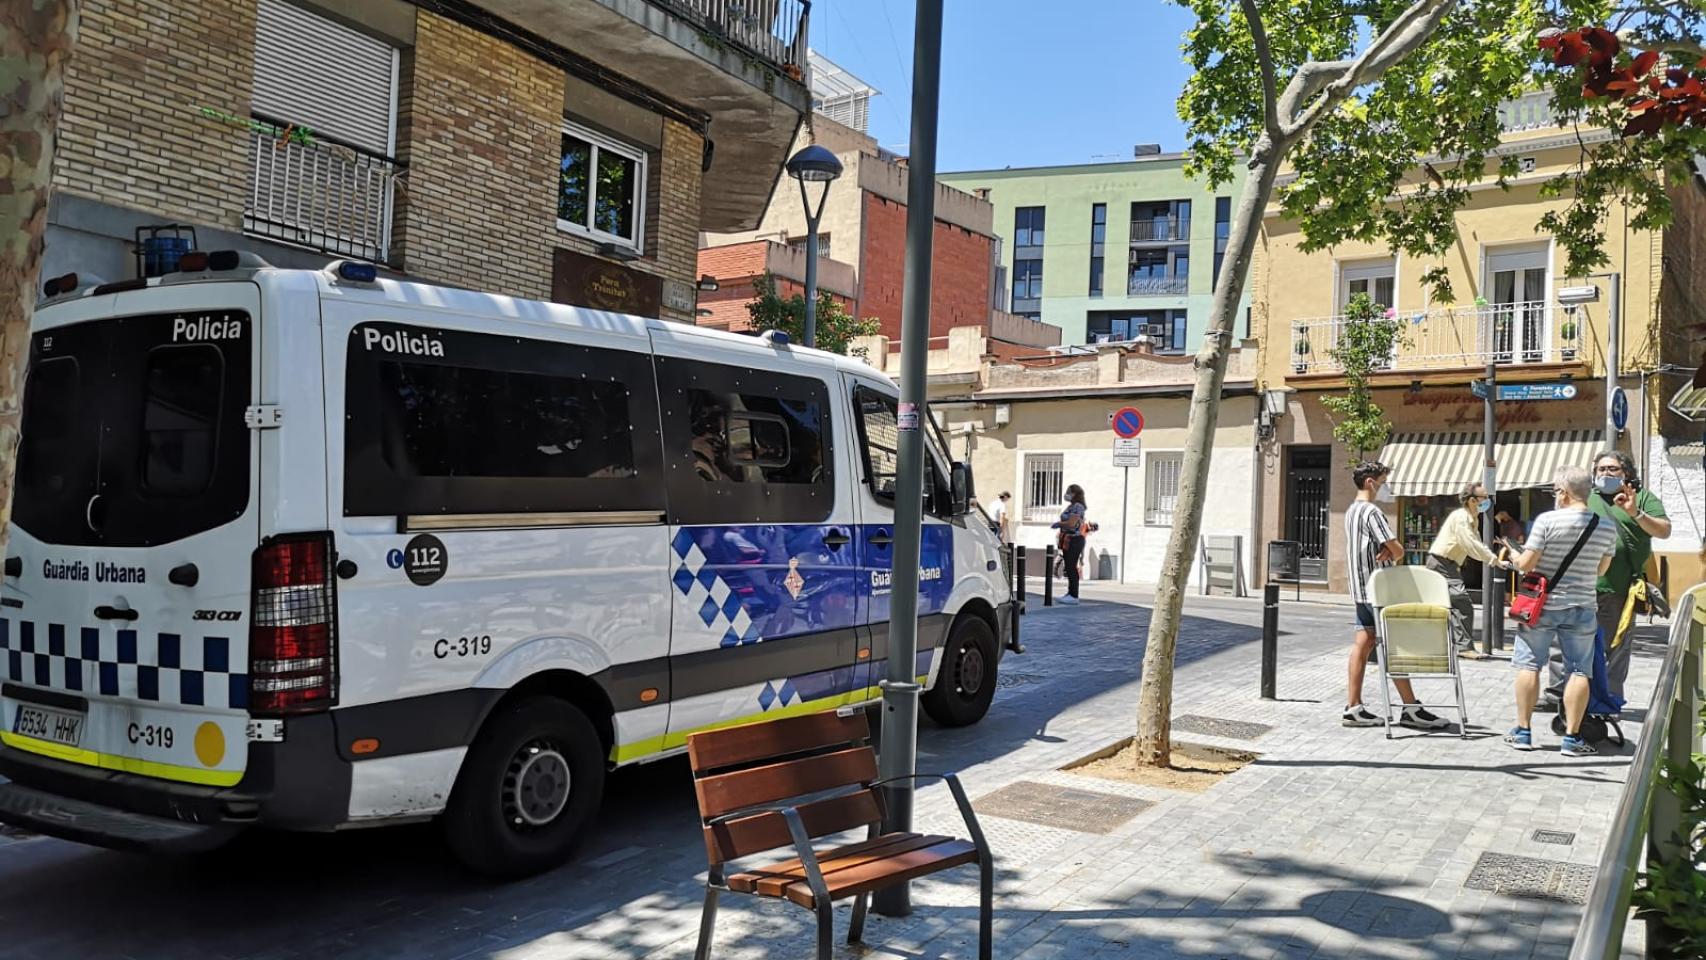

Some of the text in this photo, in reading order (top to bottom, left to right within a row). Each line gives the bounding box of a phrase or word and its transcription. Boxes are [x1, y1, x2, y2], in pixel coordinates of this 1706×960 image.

[173, 316, 241, 341] Policia
[364, 328, 444, 357] Policia
[411, 547, 441, 567] 112
[43, 559, 146, 583] Guàrdia Urbana
[217, 610, 242, 621] CDI
[433, 635, 492, 659] C-319
[21, 709, 79, 742] 6534 HHK
[128, 722, 173, 748] C-319
